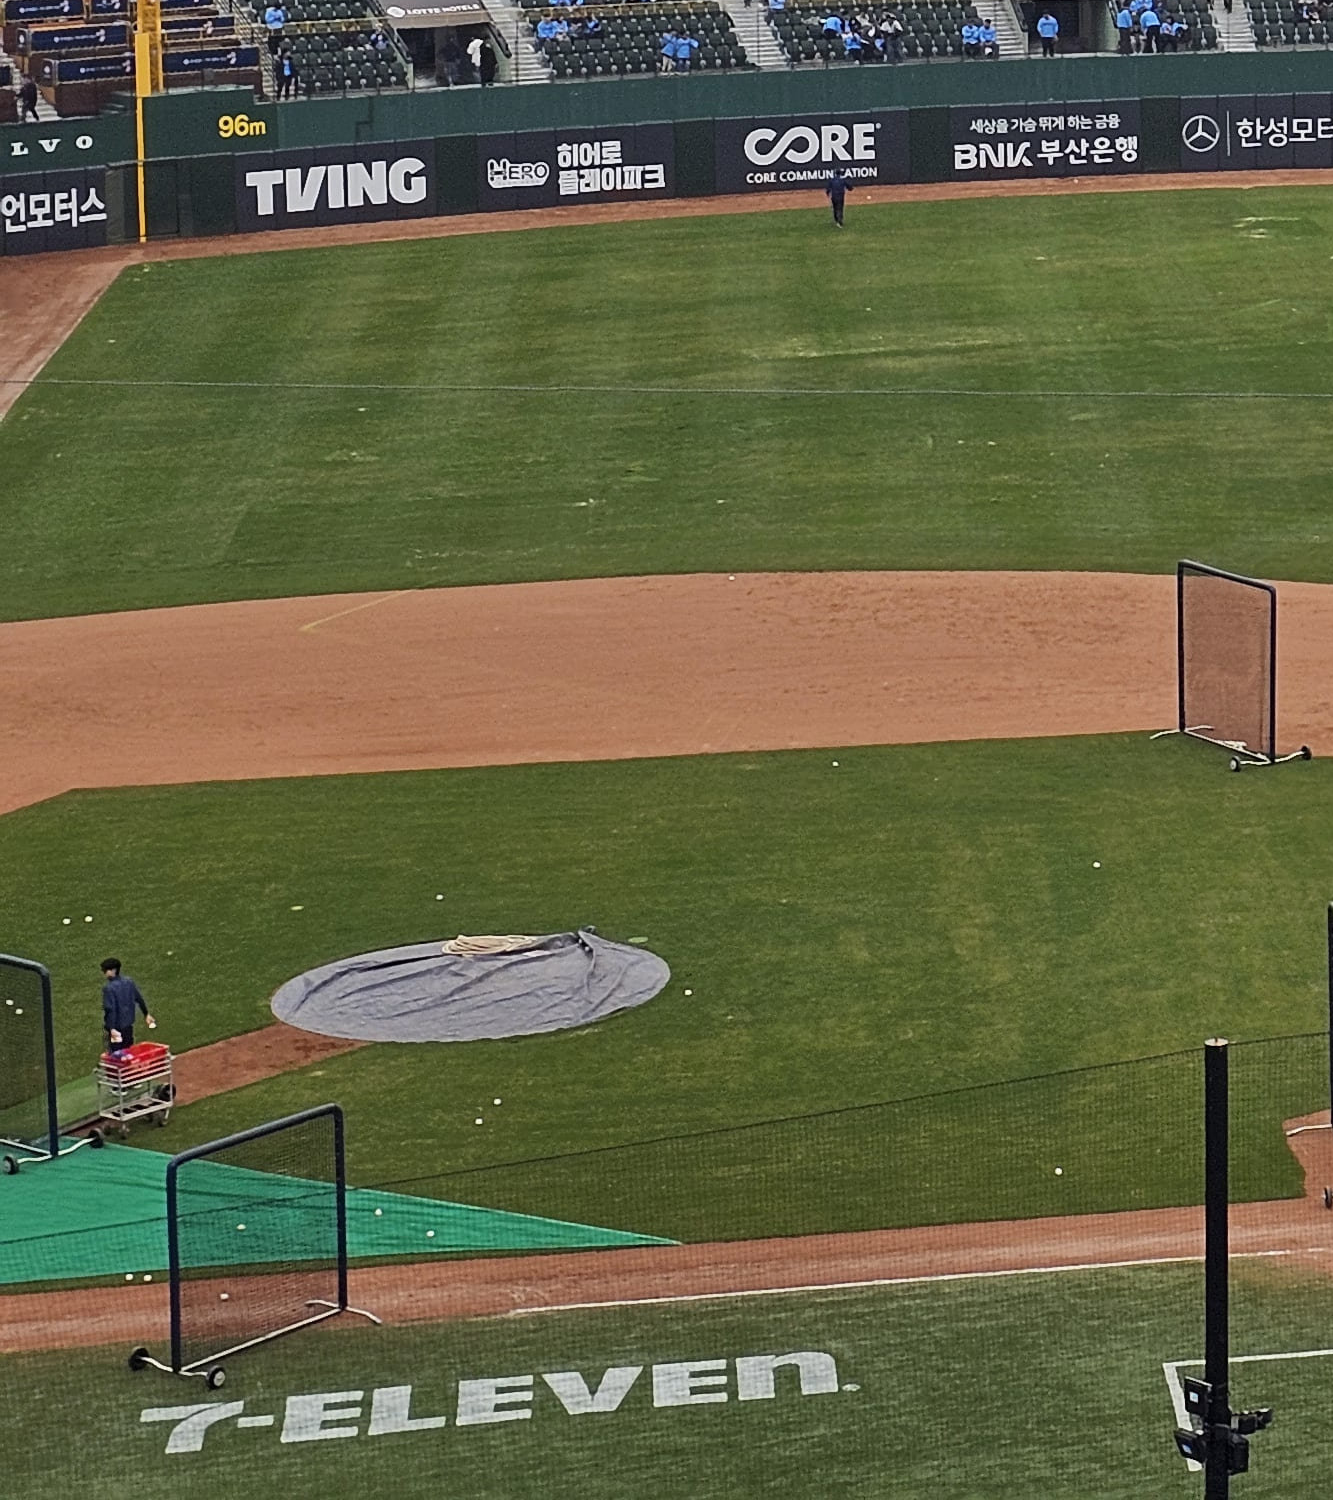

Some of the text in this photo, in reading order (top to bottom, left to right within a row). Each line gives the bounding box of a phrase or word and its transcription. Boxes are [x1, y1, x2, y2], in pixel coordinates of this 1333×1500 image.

[218, 114, 266, 137] 96m
[969, 113, 1121, 134] 세상을 가슴 뛰게 하는 금융
[556, 141, 623, 168] 히어로
[744, 123, 876, 166] CORE
[953, 135, 1139, 170] BNK 부산은행
[488, 159, 549, 183] HERO
[558, 164, 666, 195] 플레이파크
[746, 172, 777, 184] CORE
[245, 157, 427, 216] TVING
[0, 187, 107, 233] 언모터스
